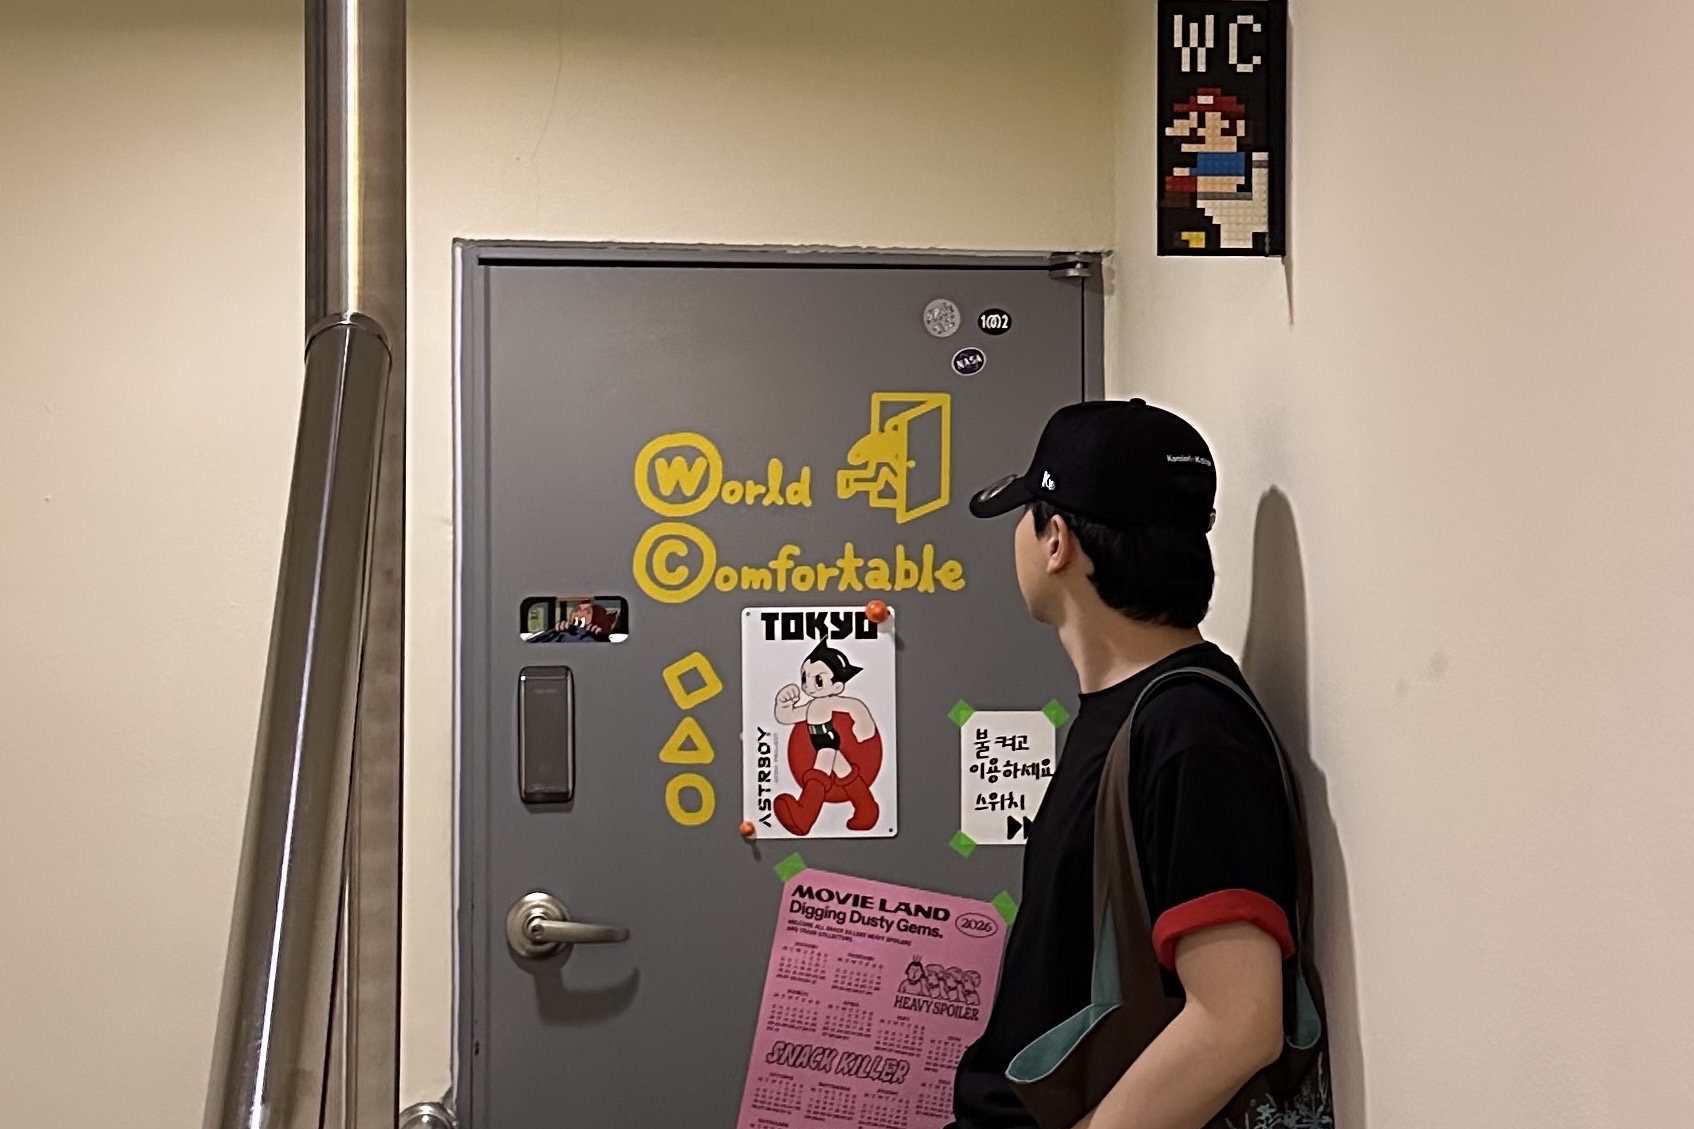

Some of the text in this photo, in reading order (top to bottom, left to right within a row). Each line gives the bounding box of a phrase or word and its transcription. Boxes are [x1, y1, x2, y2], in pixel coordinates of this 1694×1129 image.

[1173, 14, 1262, 73] WC
[980, 314, 1009, 329] 1002
[956, 354, 983, 370] NASA
[634, 432, 813, 517] World
[632, 521, 966, 604] Comfortable
[761, 611, 878, 641] TOKYO
[974, 728, 1030, 759] 불 켜고
[969, 758, 1055, 784] 이용하세요
[974, 791, 1025, 811] 스위치
[791, 884, 951, 922] MOVIE LAND
[789, 899, 944, 939] Digging Dusty Gems.
[960, 917, 993, 933] 2026
[766, 1040, 839, 1074] SNACK
[835, 1050, 911, 1085] KILLER
